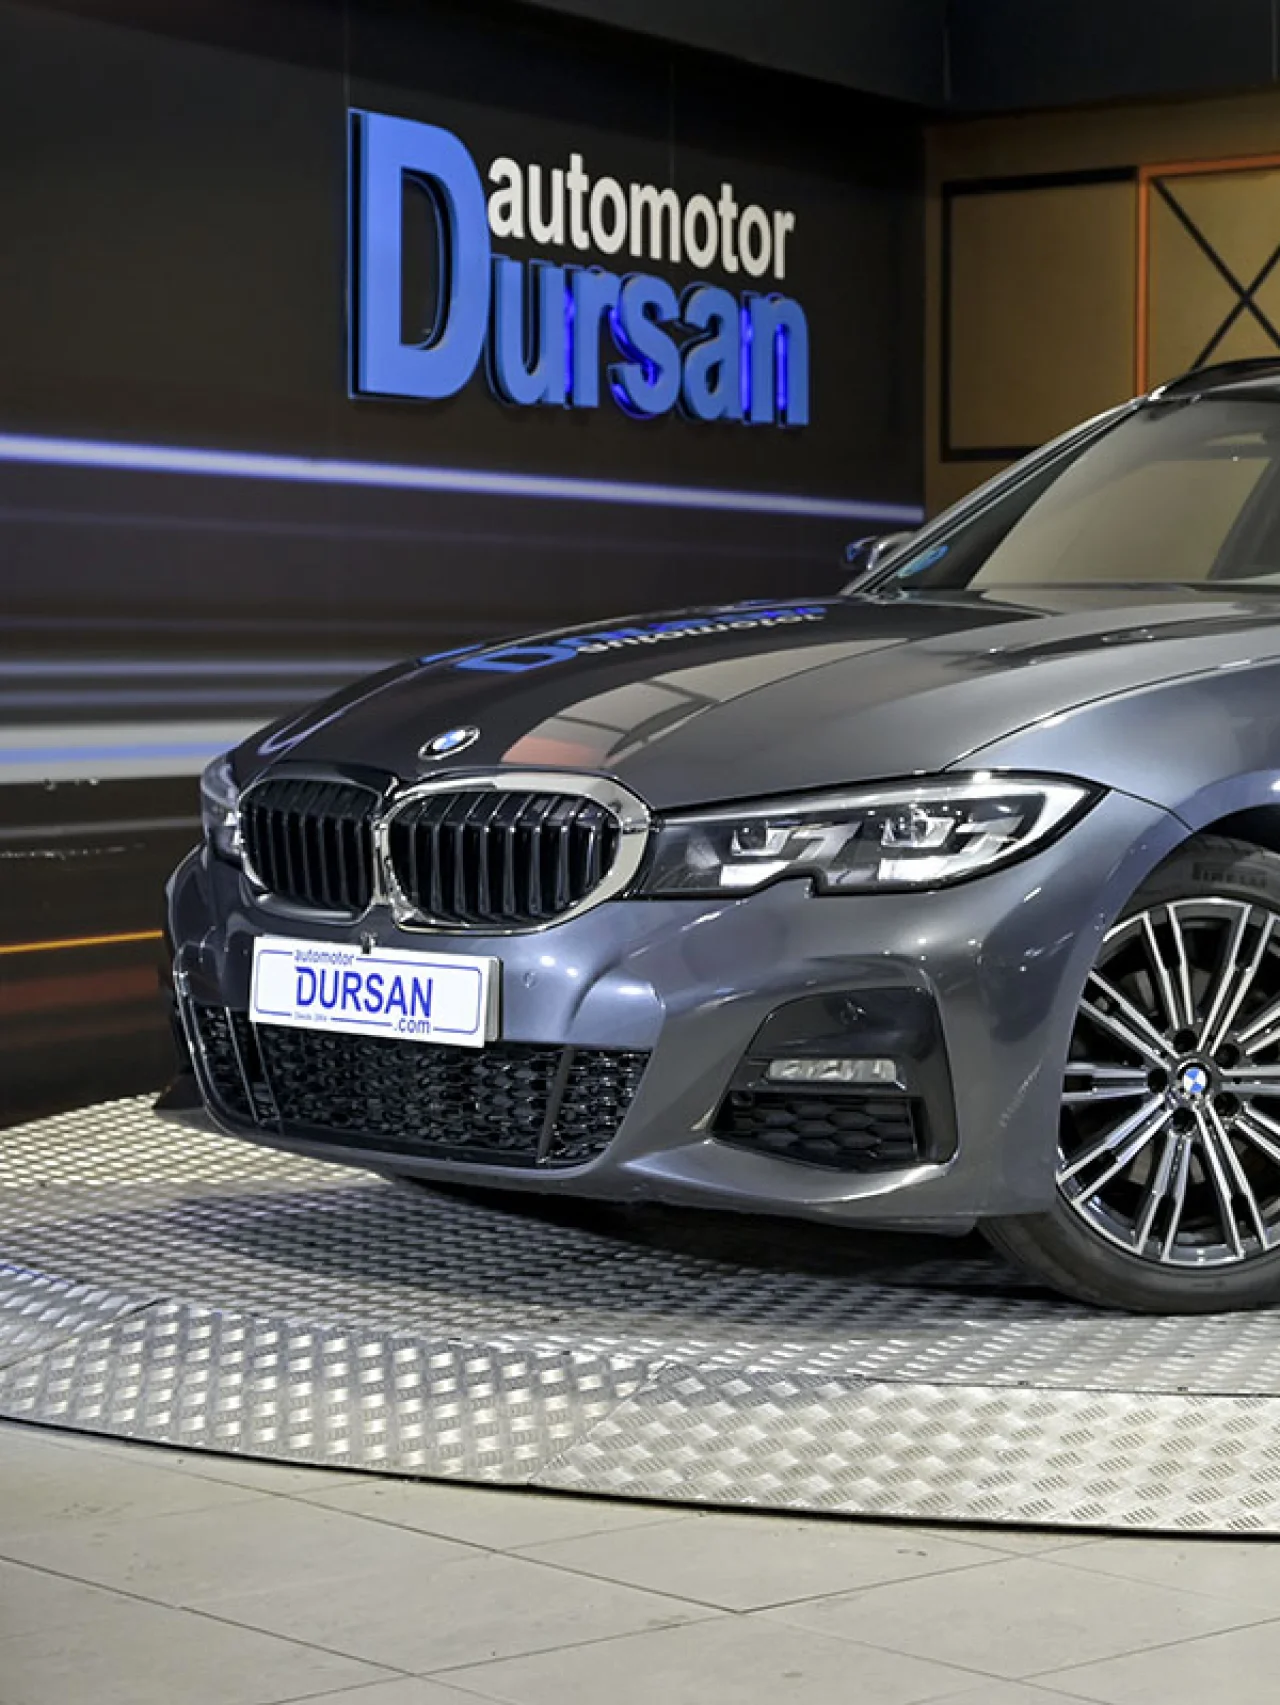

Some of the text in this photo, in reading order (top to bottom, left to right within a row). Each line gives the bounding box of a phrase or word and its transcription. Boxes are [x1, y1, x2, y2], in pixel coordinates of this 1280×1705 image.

[487, 152, 796, 280] automotor
[347, 107, 811, 428] Dursan
[294, 949, 355, 966] automotor
[295, 966, 433, 1018] DURSAN
[393, 1017, 432, 1034] .com
